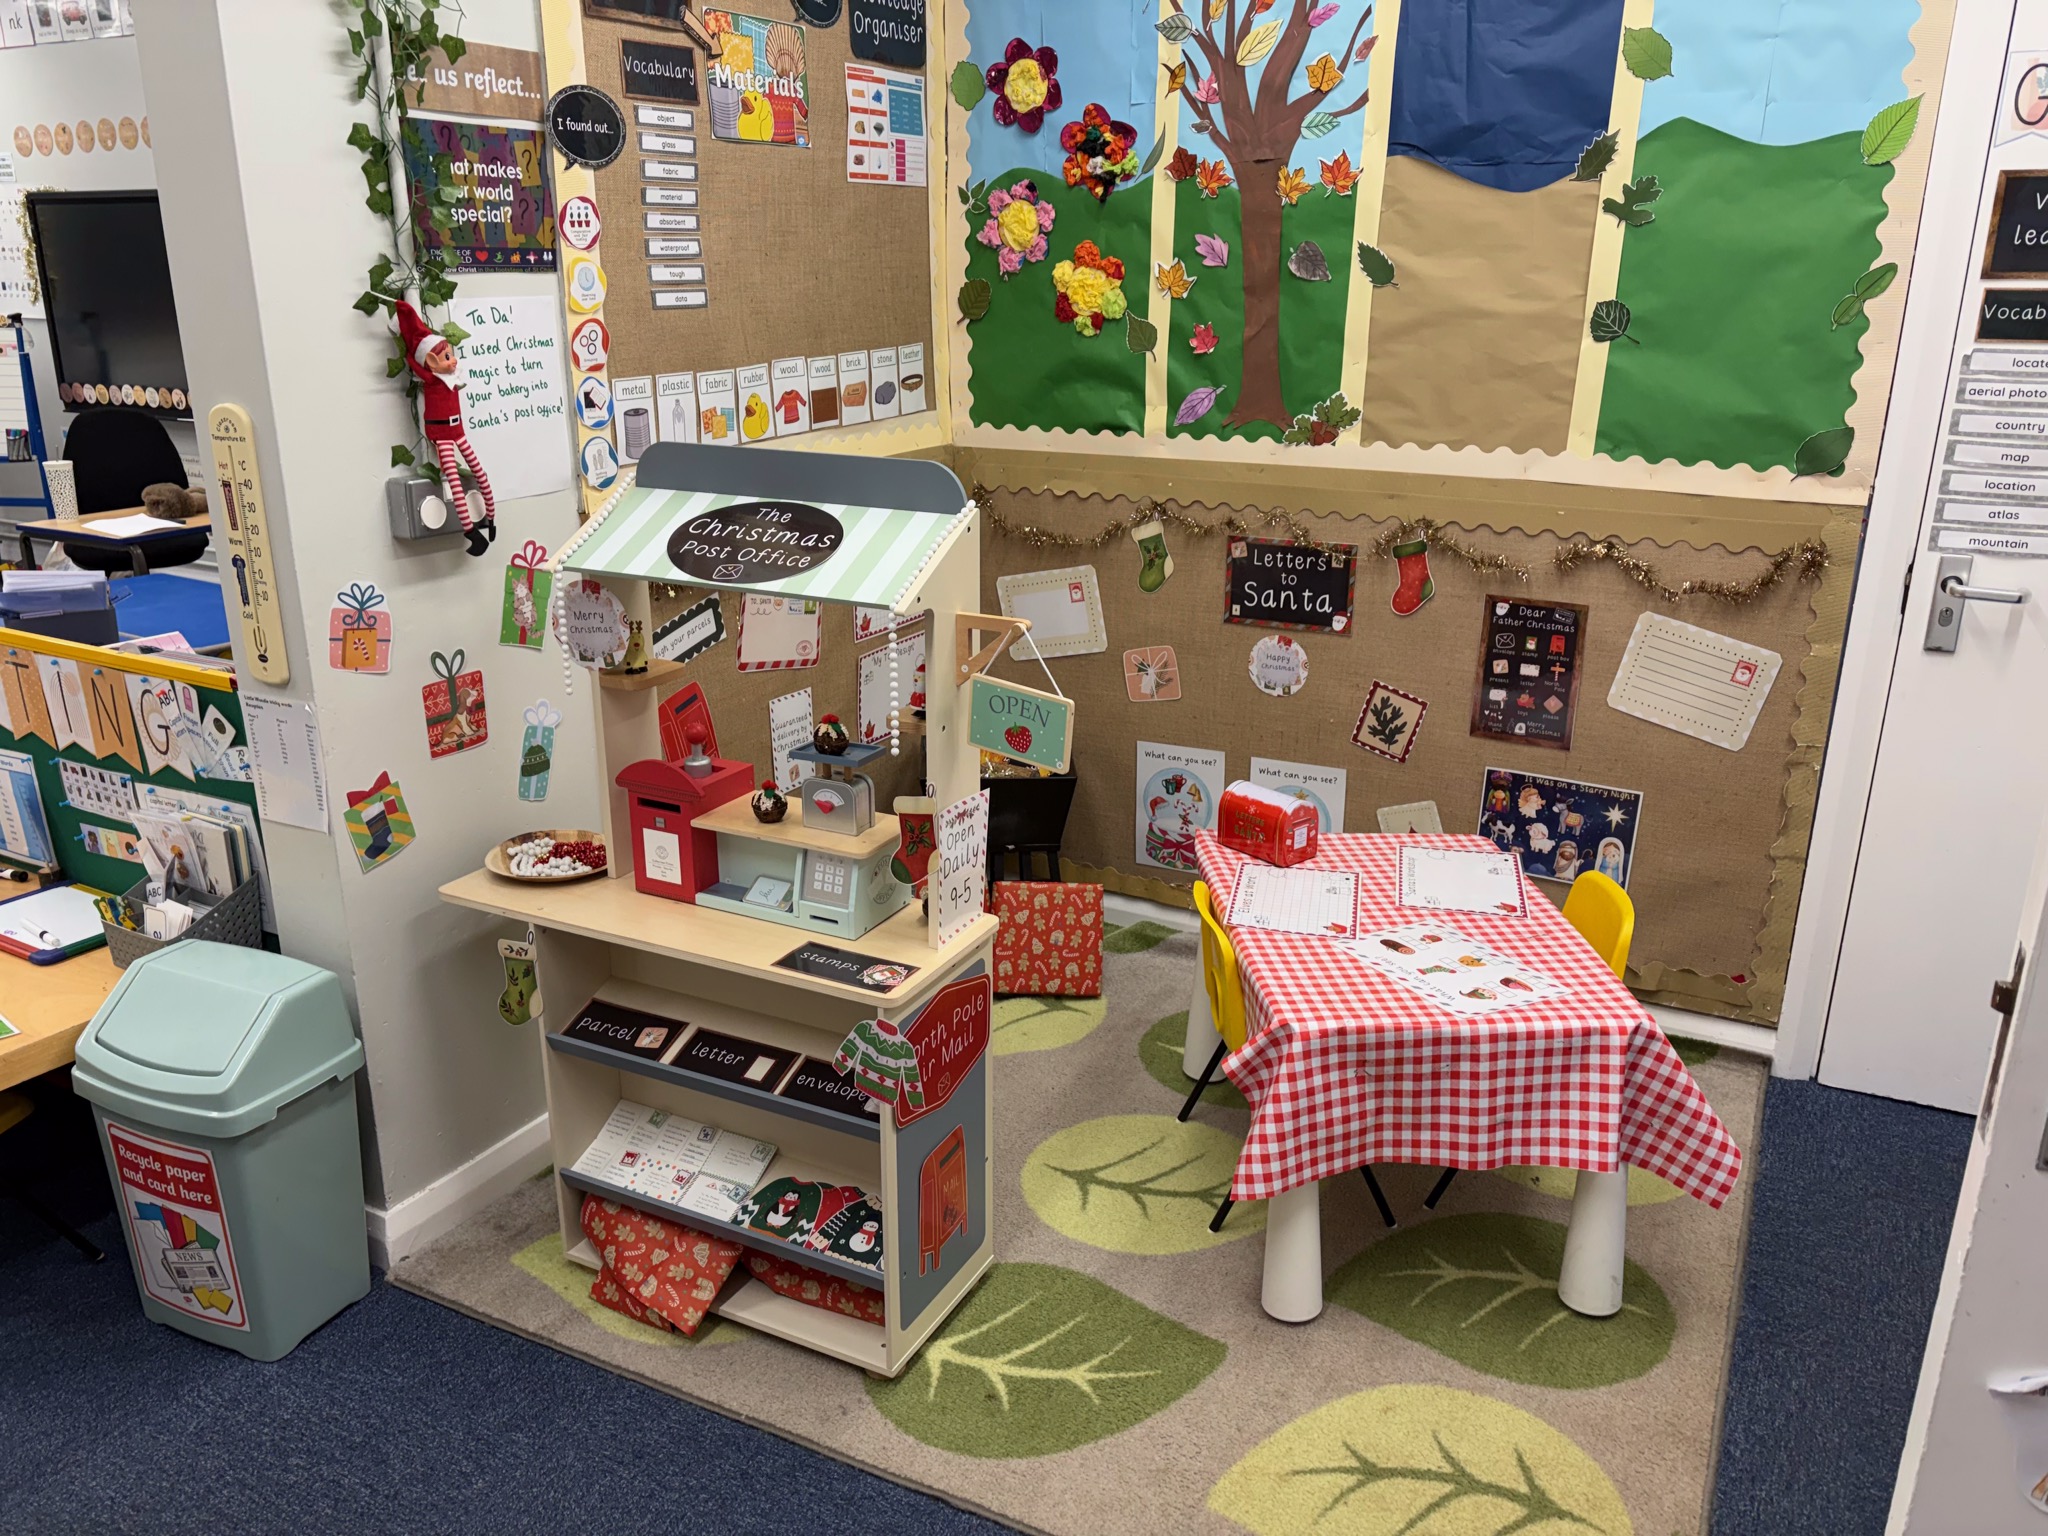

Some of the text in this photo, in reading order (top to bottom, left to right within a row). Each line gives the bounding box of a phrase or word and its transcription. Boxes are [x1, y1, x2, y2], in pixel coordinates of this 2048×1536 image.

[9, 12, 23, 30] nk
[854, 11, 923, 45] Organiser
[623, 55, 694, 85] Vocabulary
[434, 67, 458, 87] us
[465, 68, 541, 100] reflect...
[715, 62, 804, 98] Materials
[557, 118, 564, 130] I
[565, 117, 592, 132] found
[656, 115, 675, 125] object
[661, 141, 676, 150] glass
[474, 159, 523, 179] makes
[662, 168, 679, 176] fabric
[472, 185, 514, 202] world
[660, 193, 683, 201] material
[451, 206, 513, 228] special?
[659, 218, 686, 226] absorbent
[660, 244, 690, 253] waterproof
[669, 270, 686, 279] tough
[675, 295, 688, 303] data
[466, 305, 513, 326] Ta Da!
[1984, 303, 2047, 320] Vocab
[457, 335, 554, 360] I used Christmas
[902, 347, 920, 360] leather
[845, 357, 861, 369] brick
[876, 354, 893, 363] stone
[468, 356, 544, 386] magic to turn
[779, 364, 799, 374] wool
[814, 363, 831, 374] wood
[662, 377, 690, 394] plastic
[705, 376, 728, 395] fabric
[743, 371, 765, 385] rubber
[466, 381, 549, 409] your bakery into
[622, 383, 647, 395] metal
[1968, 386, 2047, 400] aerial photo
[468, 396, 563, 430] Santa's post office!
[1995, 420, 2046, 439] country
[2000, 453, 2030, 468] map
[243, 479, 253, 490] 40
[1984, 479, 2036, 492] location
[247, 502, 256, 514] 30
[756, 507, 792, 523] The
[1988, 509, 2020, 520] atlas
[250, 524, 260, 536] 20
[688, 518, 835, 548] Christmas
[254, 546, 262, 558] 10
[1968, 537, 2029, 550] mountain
[679, 540, 811, 568] Post Office
[1253, 548, 1327, 571] Letters
[1281, 572, 1298, 585] to
[1244, 581, 1333, 614] Santa
[243, 610, 254, 620] Cold
[573, 610, 604, 624] Merry
[1519, 606, 1546, 618] Dear
[569, 625, 613, 634] Christmas
[1493, 616, 1575, 633] Father Christmas
[655, 617, 711, 659] eigh your parcels
[1266, 653, 1291, 664] Happy
[1261, 663, 1295, 672] Christmas
[159, 690, 175, 710] ABC
[988, 694, 1052, 728] OPEN
[776, 725, 808, 741] delivery by
[1526, 721, 1546, 729] Merry
[1528, 728, 1561, 737] Christmas
[776, 735, 809, 753] Christmas
[1144, 750, 1218, 767] What can you see?
[1258, 767, 1338, 784] What can you see?
[1524, 774, 1636, 802] It Was on a Starry Night
[946, 824, 976, 851] Open
[943, 843, 980, 880] Daily
[147, 886, 162, 899] ABC
[950, 877, 971, 910] 9-5
[800, 950, 860, 973] stamps
[575, 1016, 637, 1042] parcel
[914, 994, 984, 1061] orth Pole
[691, 1041, 745, 1066] letter
[922, 1021, 974, 1082] ir Mail
[118, 1143, 207, 1184] Recycle paper
[123, 1166, 213, 1204] and card here
[175, 1251, 204, 1262] NEWS
